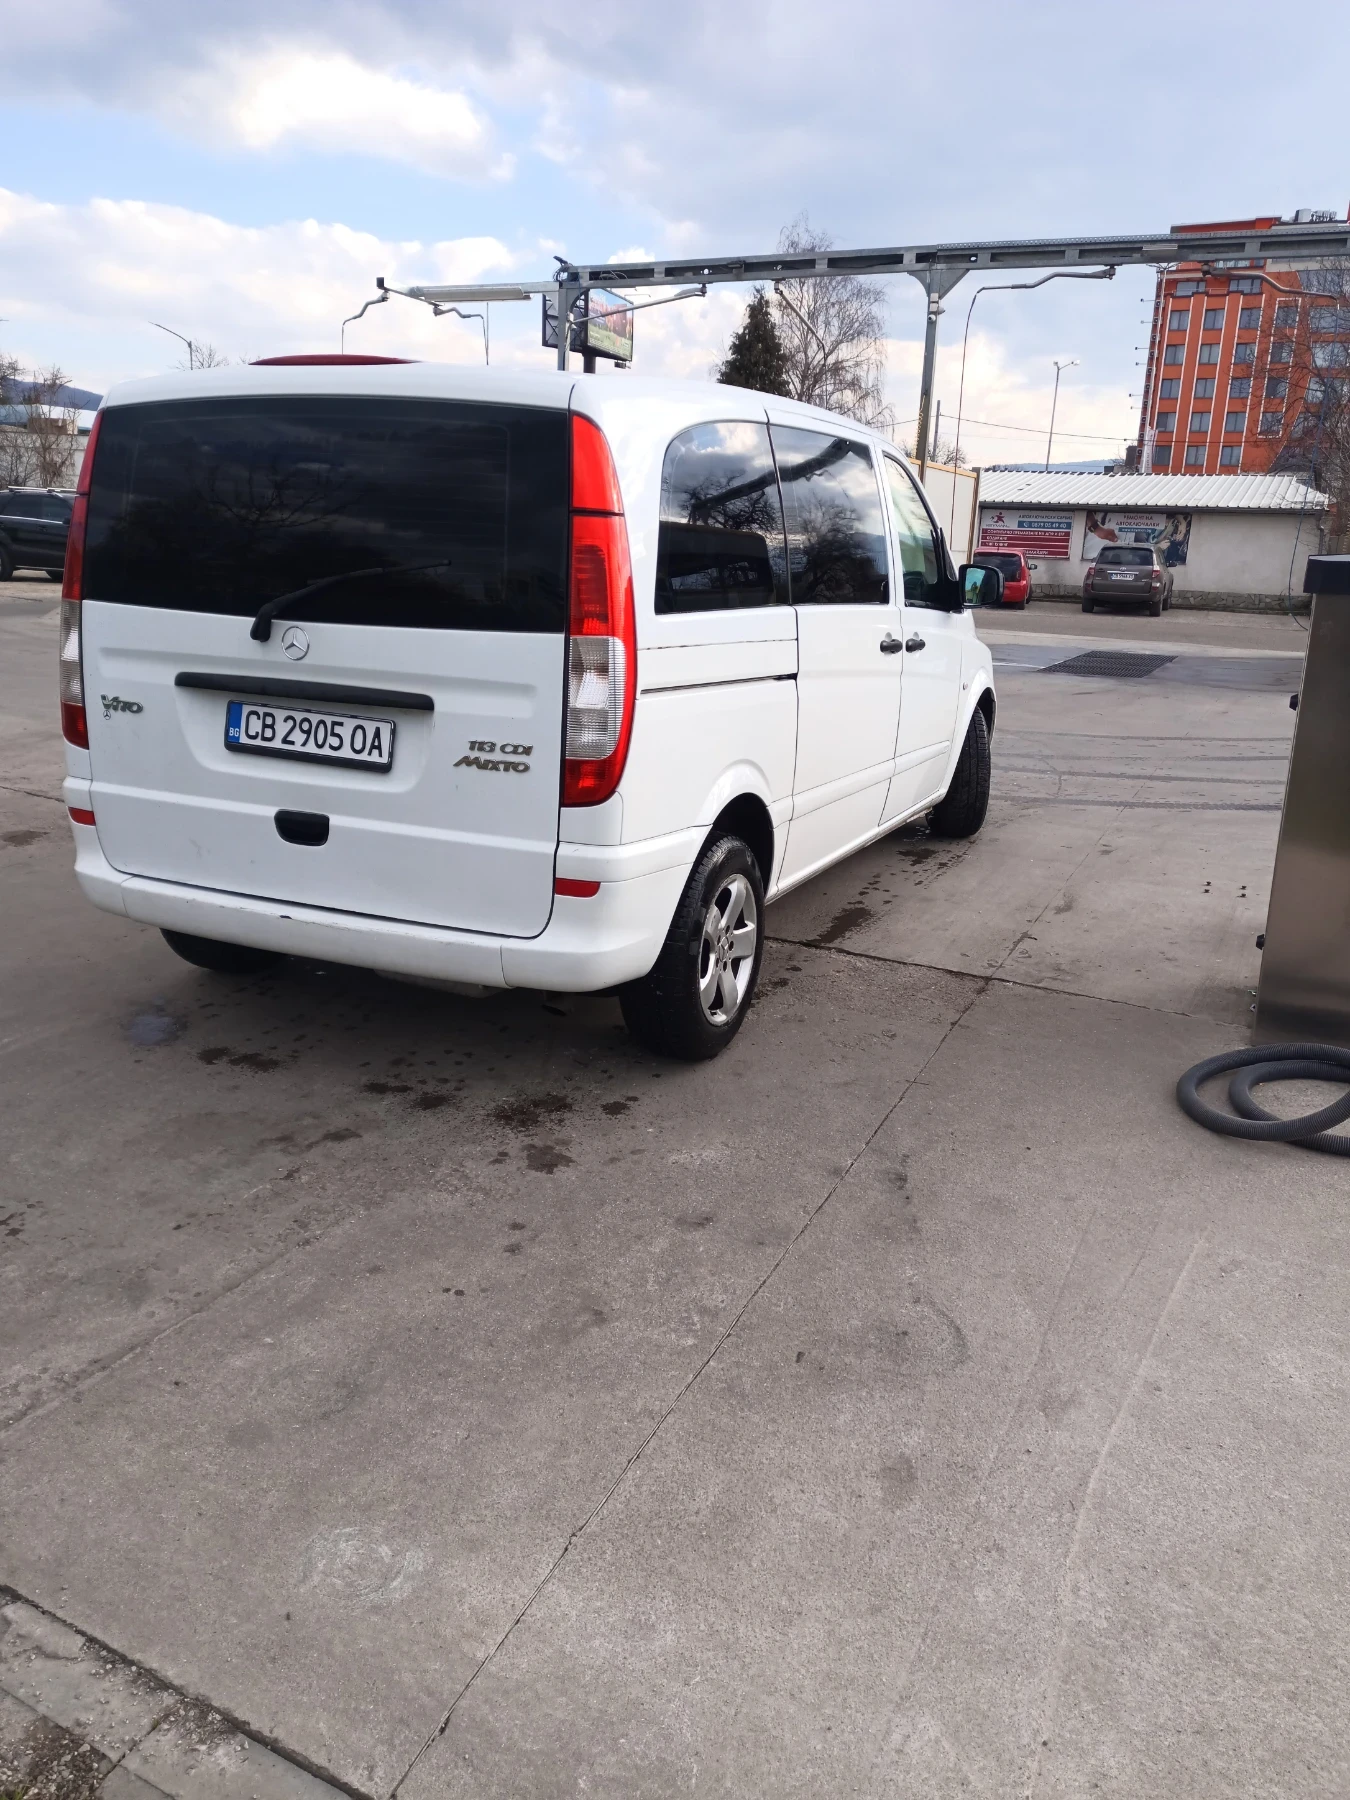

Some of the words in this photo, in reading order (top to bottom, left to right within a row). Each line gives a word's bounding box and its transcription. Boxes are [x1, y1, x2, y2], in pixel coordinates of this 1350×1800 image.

[228, 727, 240, 737] BG
[244, 710, 276, 742] CB
[281, 715, 344, 751] 2905
[350, 724, 383, 758] OA
[468, 740, 496, 753] 113
[499, 743, 534, 756] CDI
[453, 755, 531, 773] MIXTO
